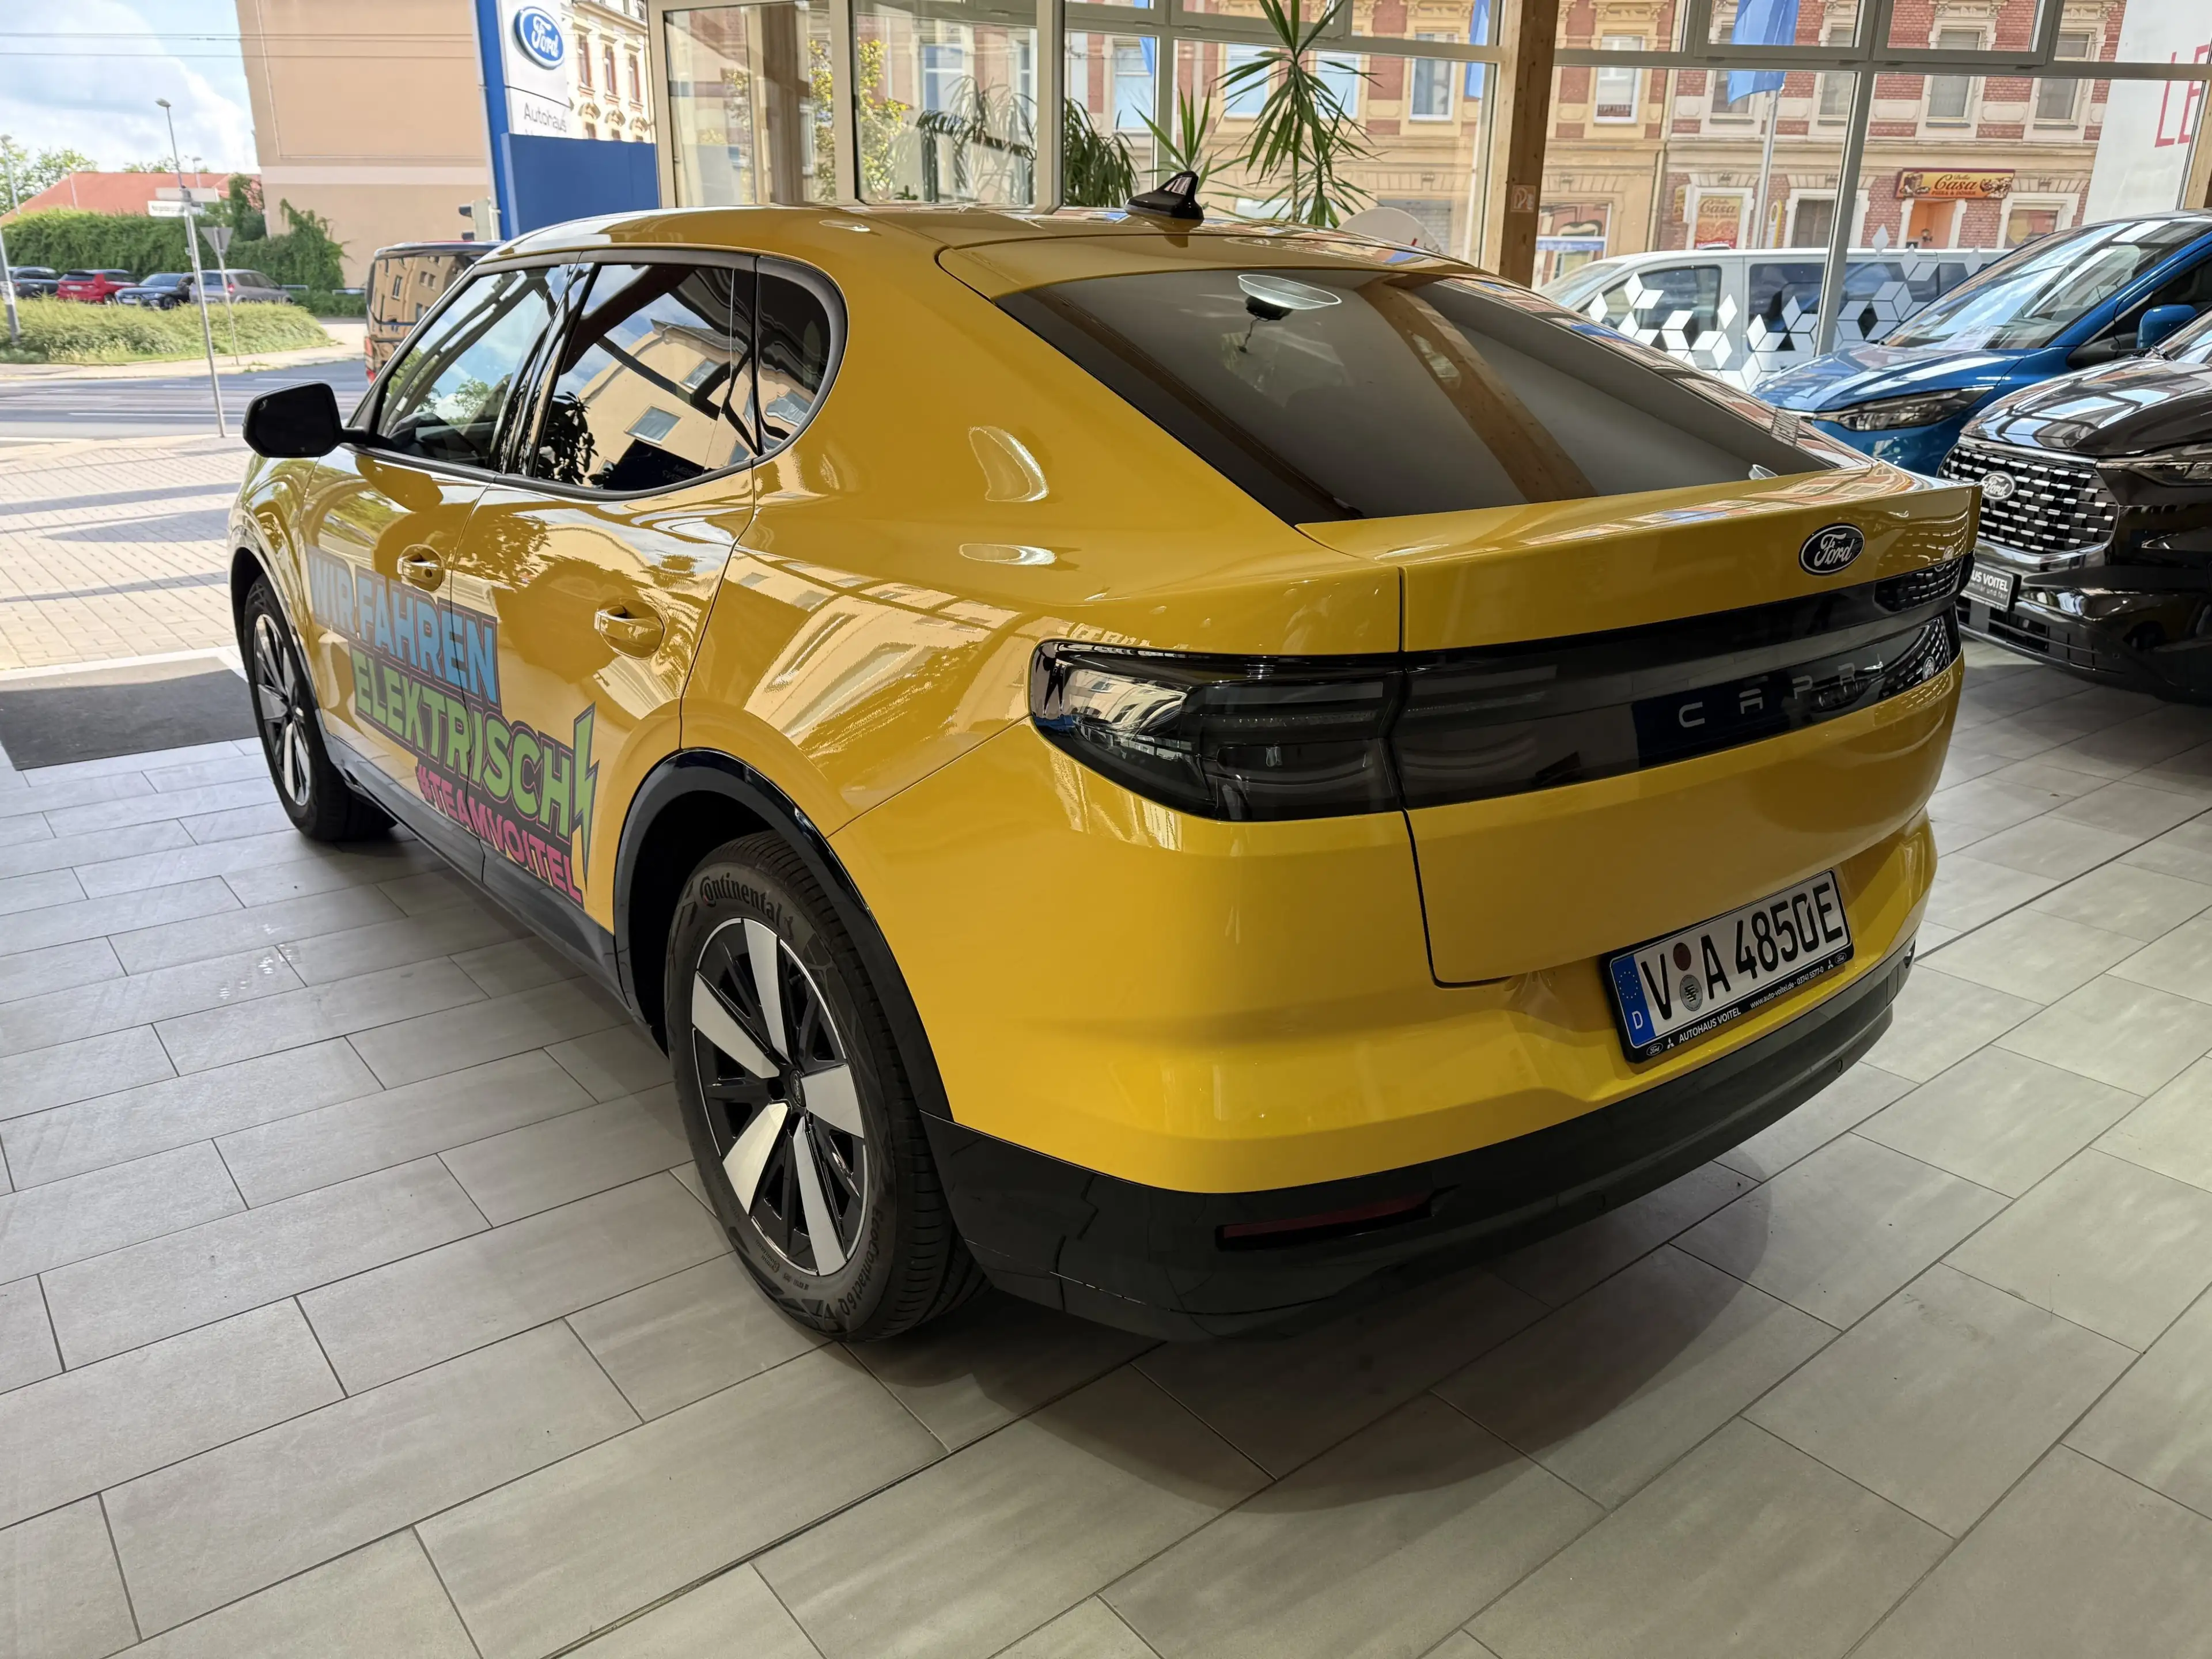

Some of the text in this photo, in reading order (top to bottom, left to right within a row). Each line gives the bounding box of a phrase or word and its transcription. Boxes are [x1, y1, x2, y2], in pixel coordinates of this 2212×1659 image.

[531, 15, 559, 57] Ford
[524, 103, 567, 132] Autohaus
[1934, 174, 1978, 191] Casa
[1700, 199, 1737, 213] Casa
[1983, 476, 2009, 497] Ford
[1813, 533, 1855, 566] Ford
[1983, 573, 2009, 592] VOITEL
[309, 552, 498, 704] WIR FAHREN
[351, 649, 573, 838] ELEKTRISCH
[416, 763, 582, 903] #TEAMVOITEL
[699, 872, 783, 926] Continental
[1734, 882, 1843, 979] 4850E
[1750, 981, 1794, 1009] www.auto-voitel.de
[1631, 1010, 1643, 1030] D
[1679, 1007, 1741, 1043] AUTOHAUS VOITEL
[855, 1207, 884, 1301] EcoContact
